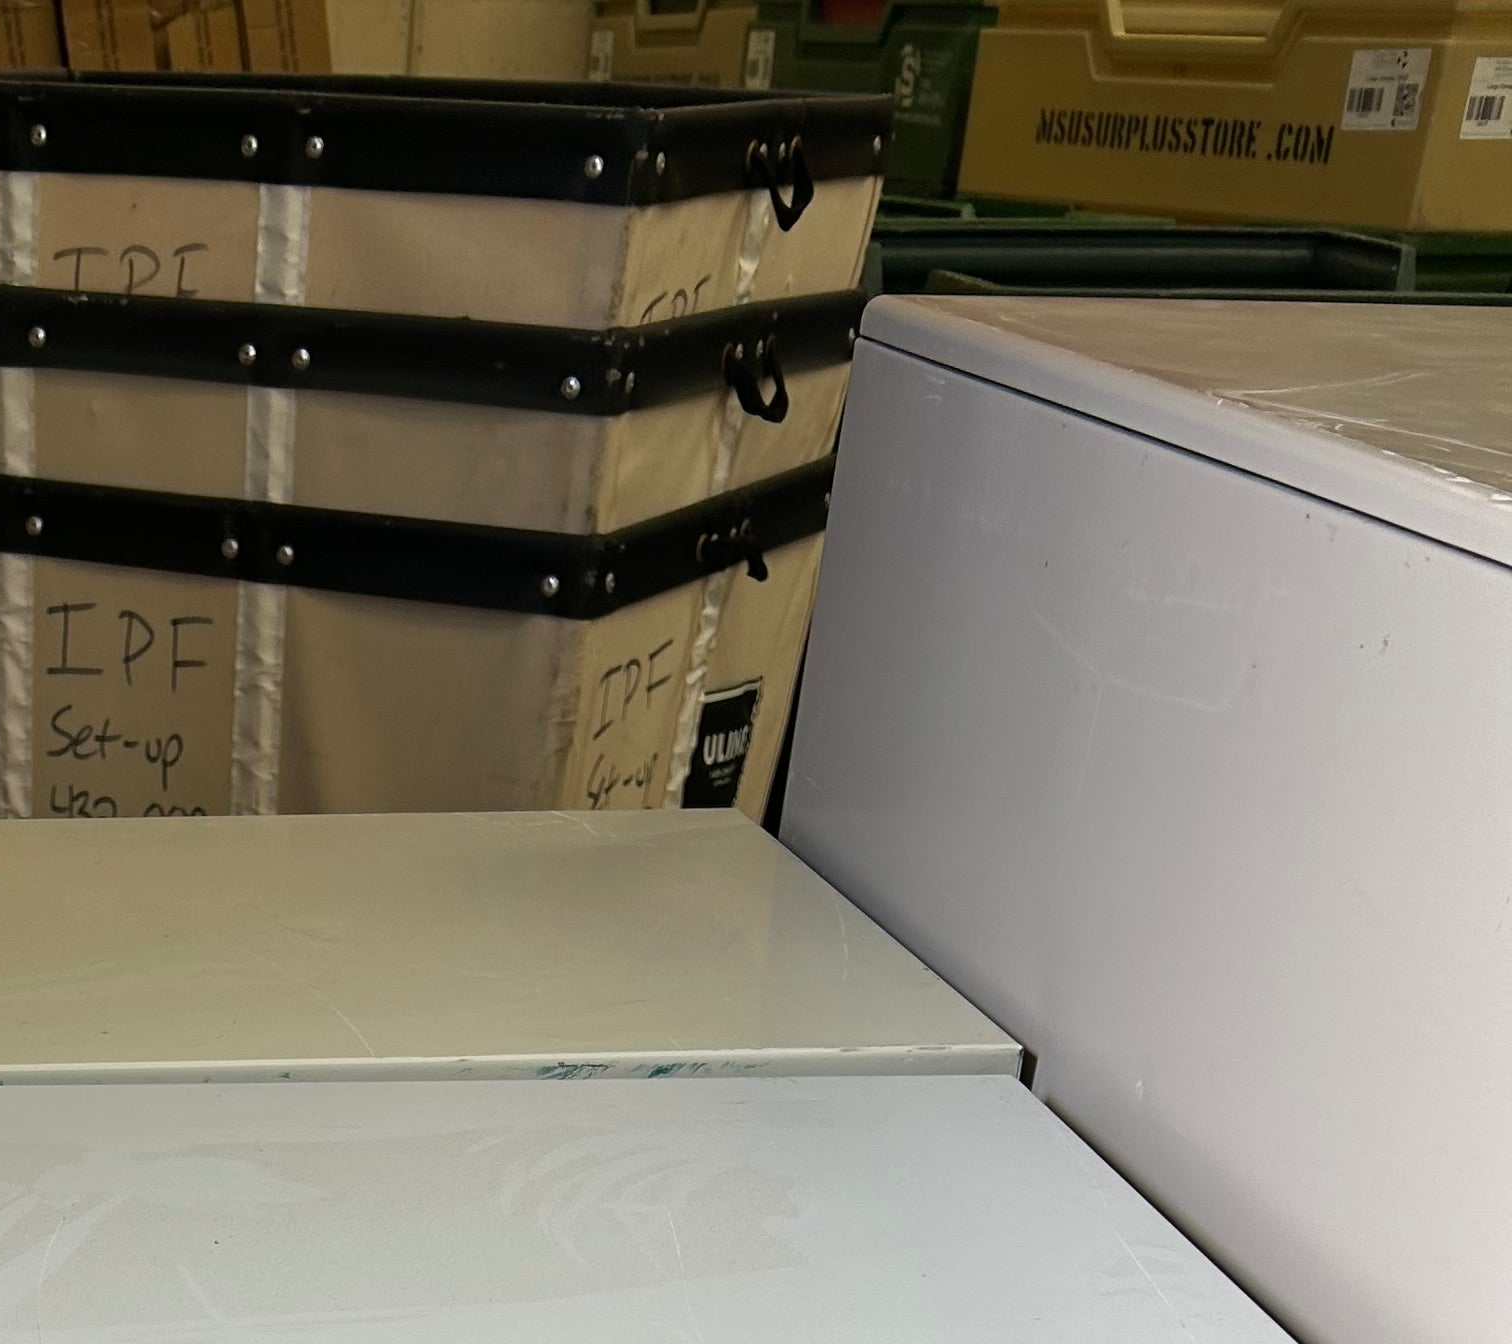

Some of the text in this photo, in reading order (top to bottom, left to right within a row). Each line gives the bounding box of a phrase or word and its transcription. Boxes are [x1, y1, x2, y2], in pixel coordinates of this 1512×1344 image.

[1036, 108, 1262, 159] MSUSURPLUSSTORE
[46, 602, 214, 692] IPF
[593, 637, 674, 740] IPF
[46, 704, 184, 791] Set-up
